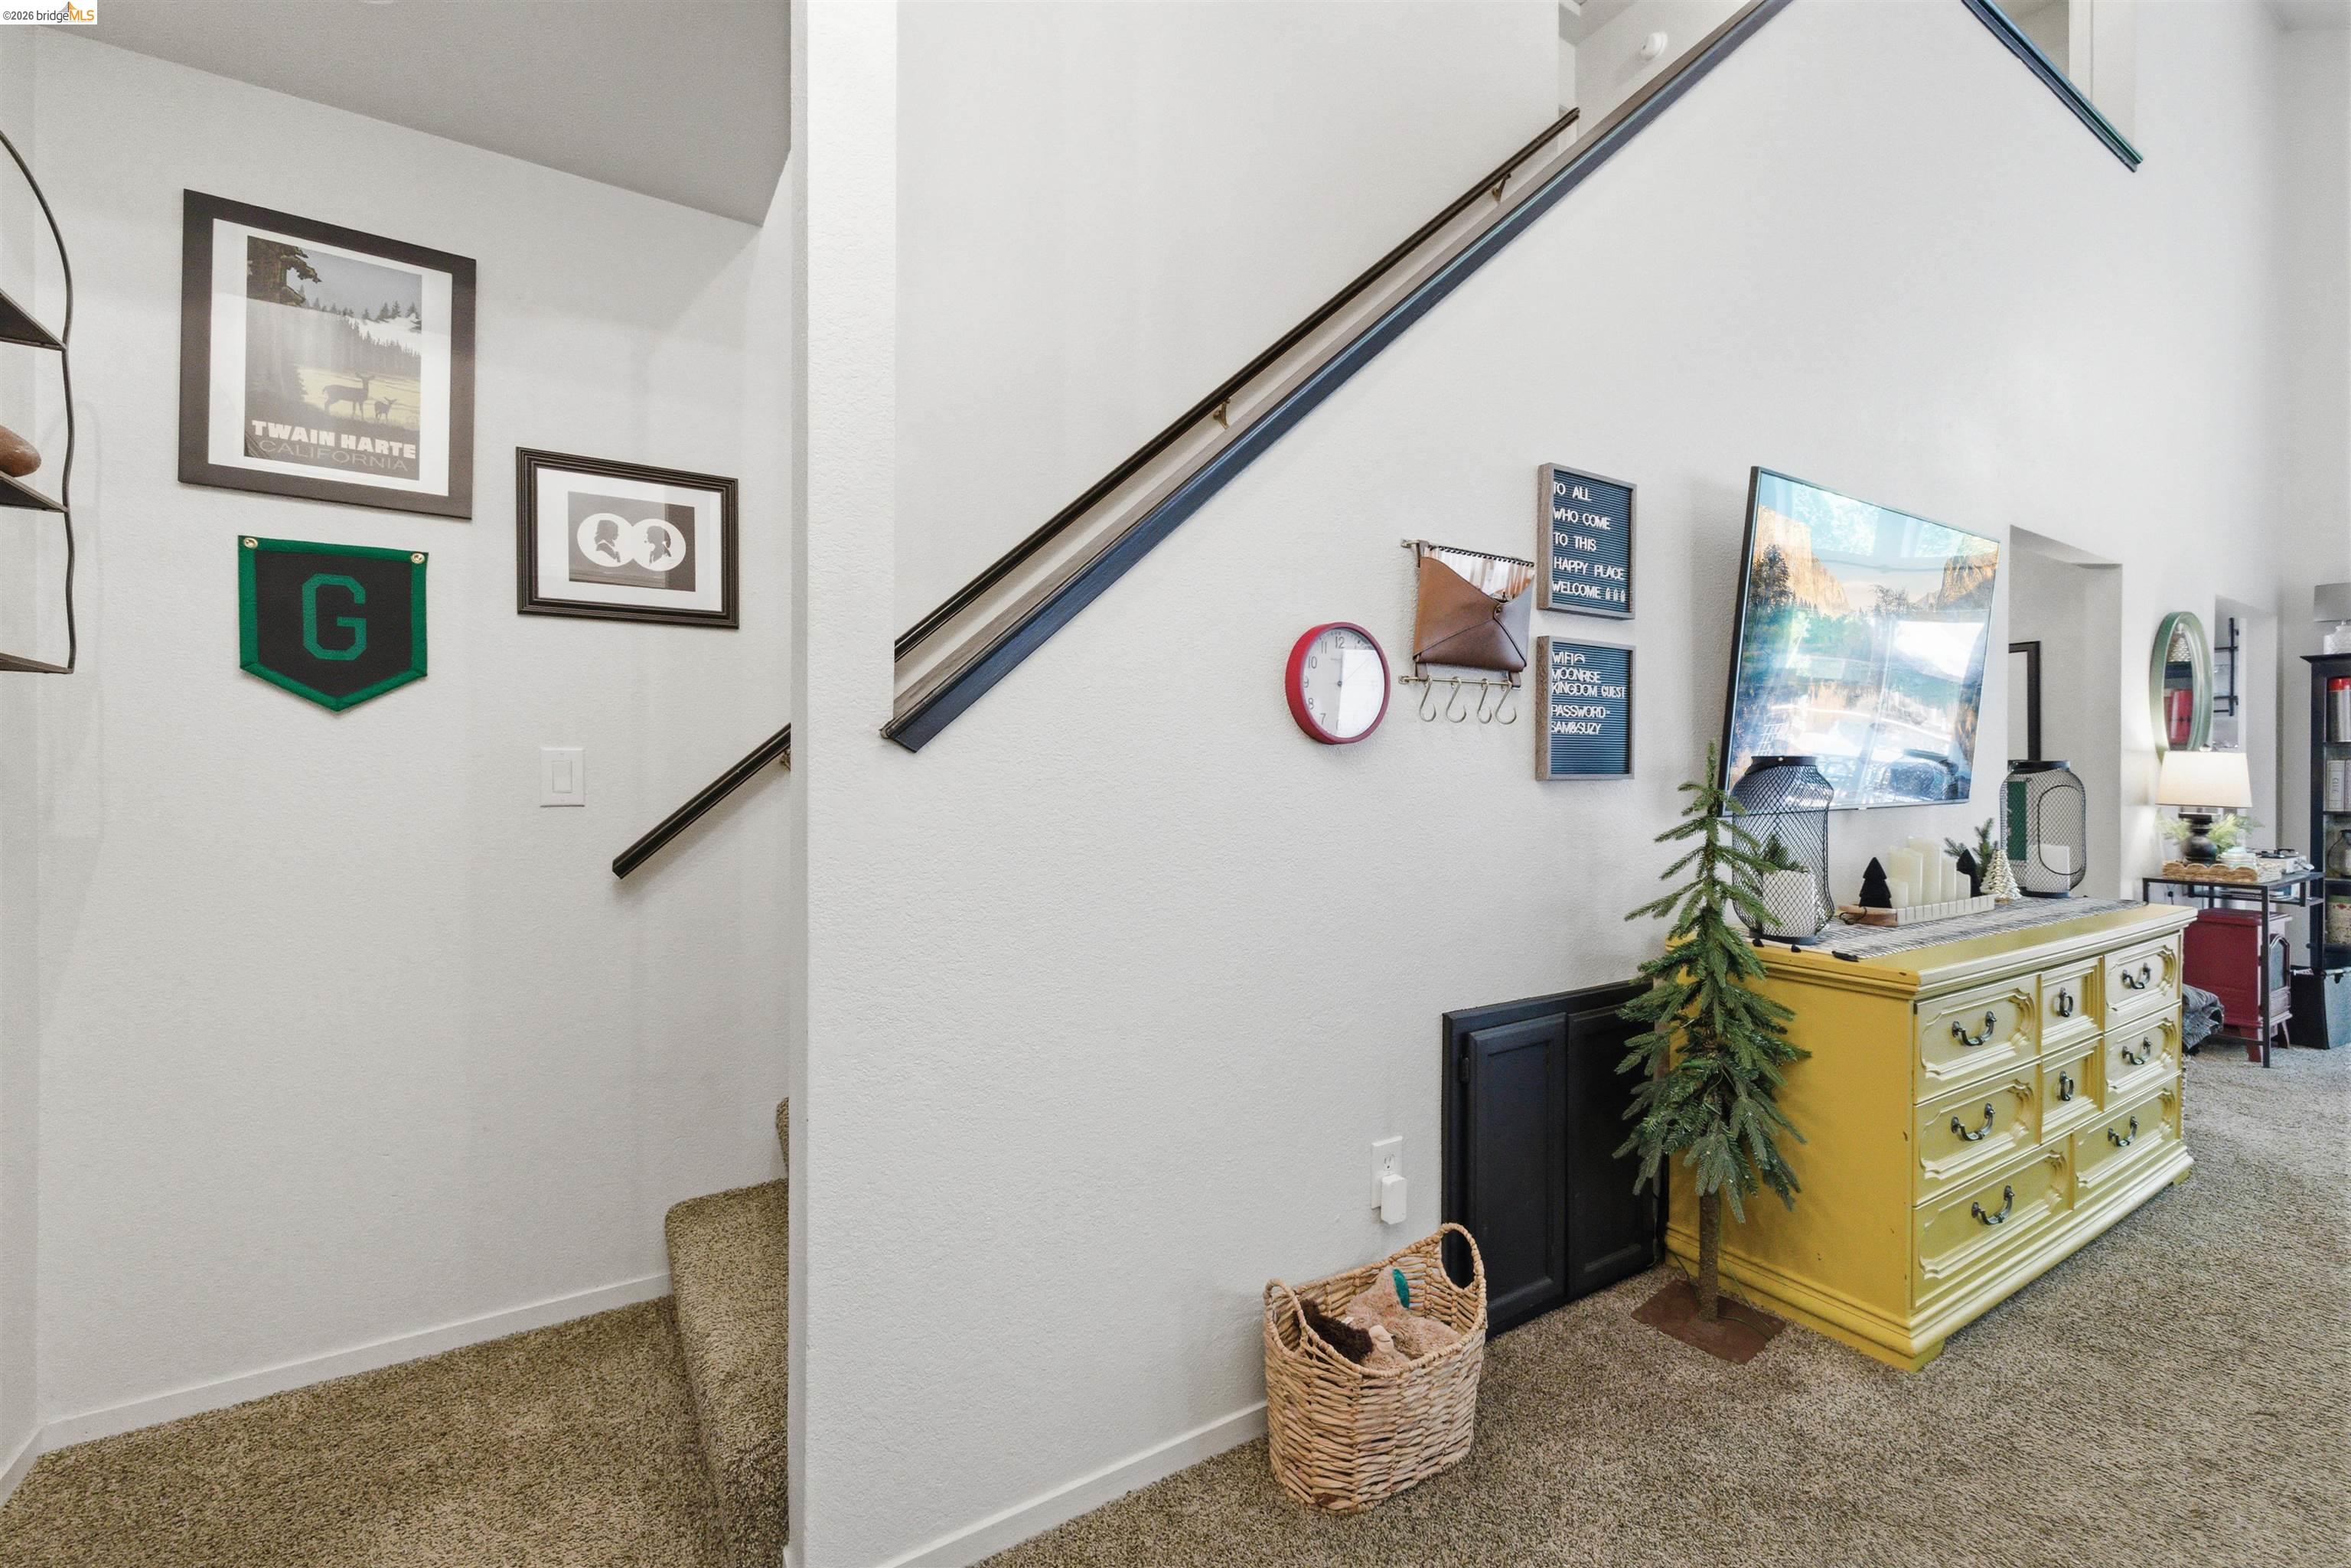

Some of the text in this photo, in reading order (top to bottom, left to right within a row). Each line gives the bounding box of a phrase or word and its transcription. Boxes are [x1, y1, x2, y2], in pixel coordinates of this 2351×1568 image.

[252, 420, 416, 459] TWAIN HARTE
[259, 440, 408, 471] CALIFORNIA
[1554, 482, 1592, 501] TO ALL
[1554, 507, 1611, 530] WHO COME
[1554, 532, 1596, 551] TO THIS
[1554, 556, 1625, 580] HAPPY PLACE
[1552, 580, 1601, 599] WELCOME
[302, 573, 367, 661] G
[1321, 641, 1328, 654] 11
[1335, 636, 1345, 649] 12
[1308, 656, 1318, 669] 10
[1552, 667, 1602, 683] MOONRISE
[1552, 682, 1625, 698] KINGDOM GUEST
[1308, 697, 1314, 710] 8
[1320, 712, 1326, 725] 7
